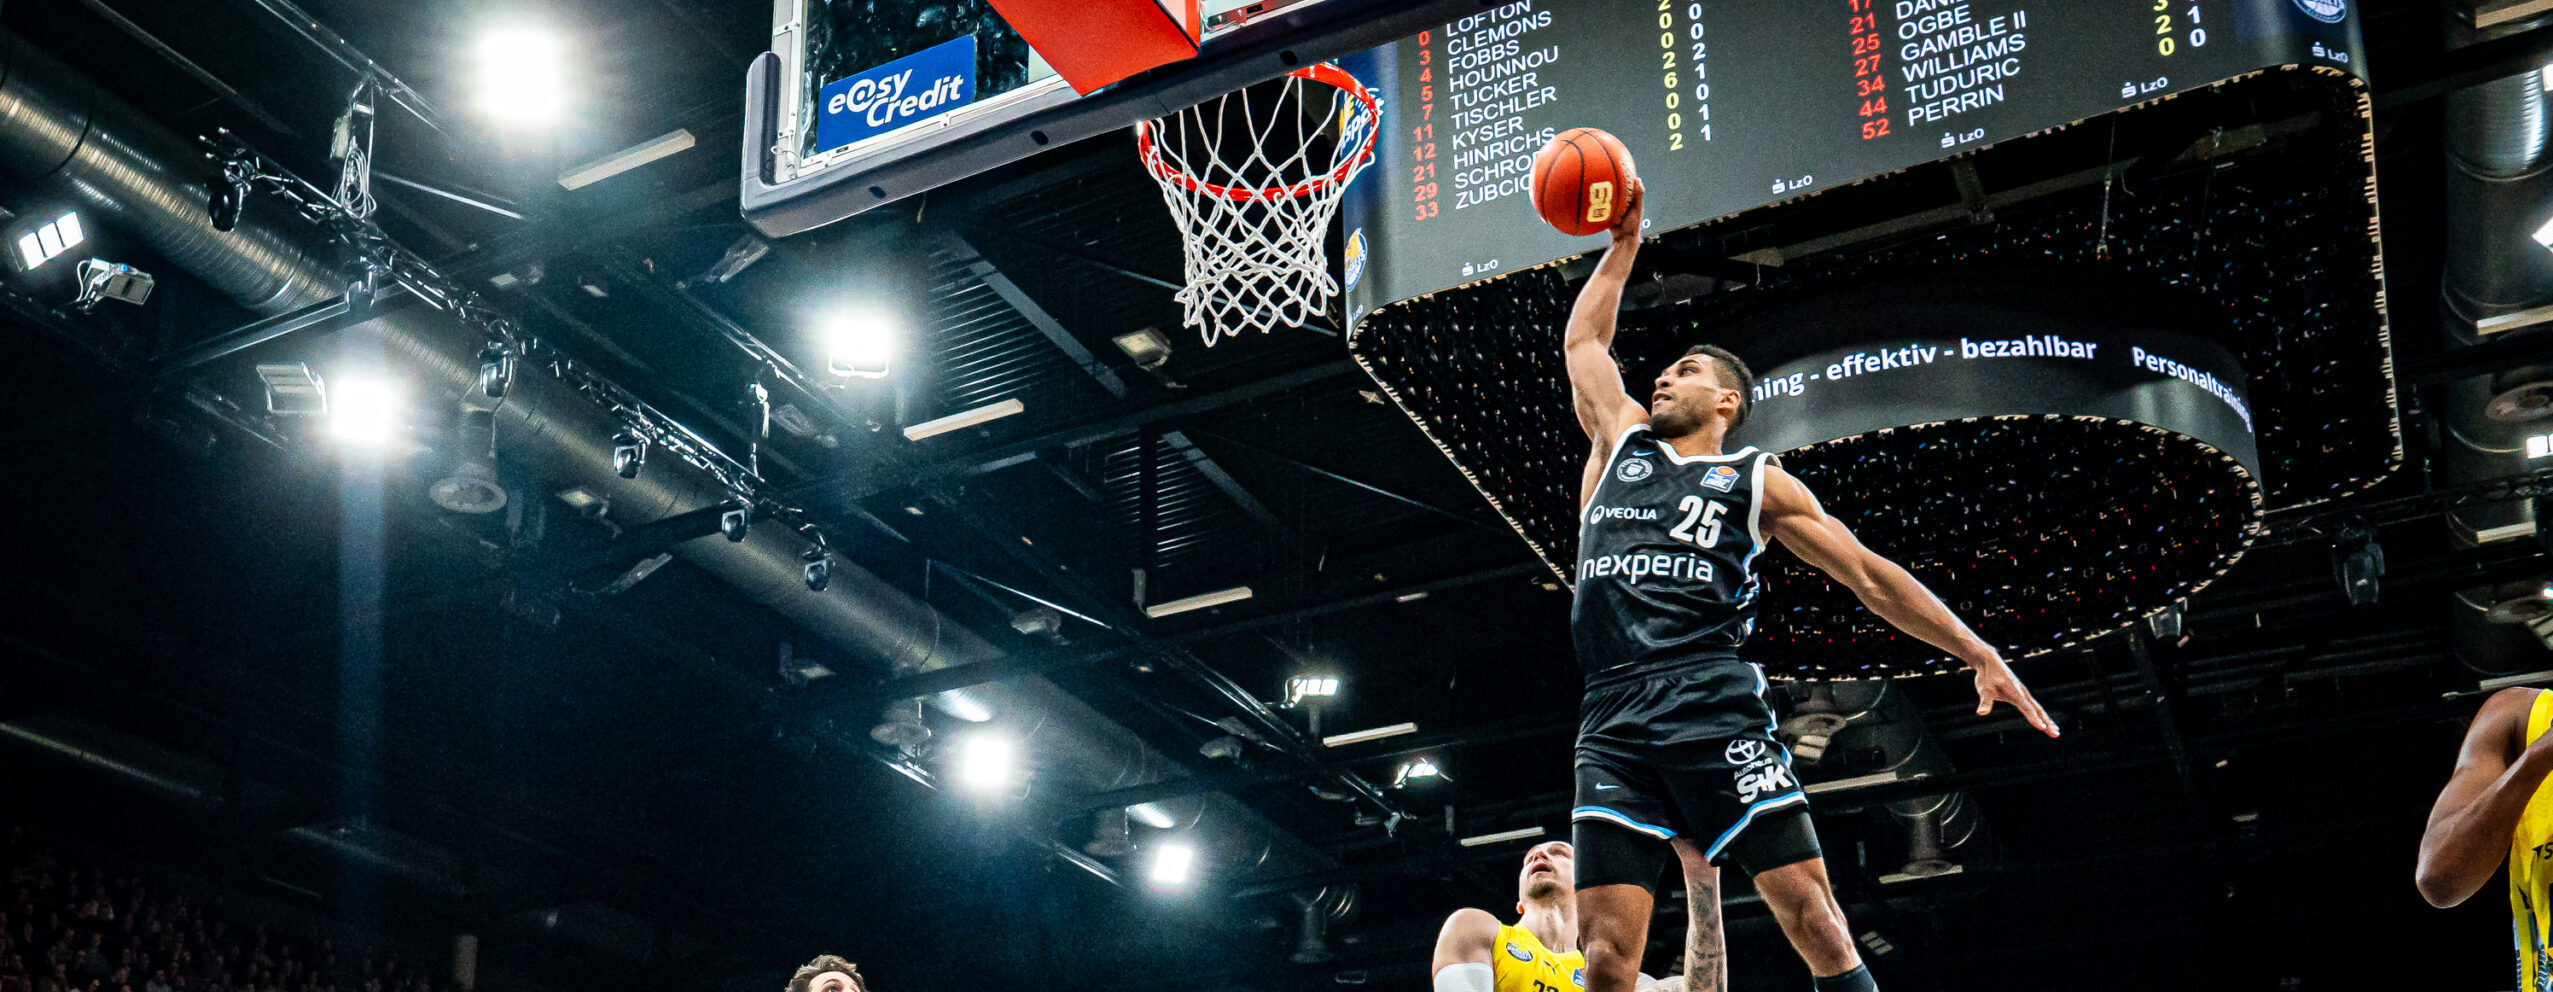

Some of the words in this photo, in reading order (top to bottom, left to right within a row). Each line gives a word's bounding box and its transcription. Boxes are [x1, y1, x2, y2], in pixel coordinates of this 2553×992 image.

[1418, 30, 1430, 47] 0
[1446, 0, 1531, 37] LOFTON
[1659, 12, 1672, 29] 0
[1688, 3, 1702, 20] 0
[1850, 12, 1875, 35] 21
[1898, 4, 1972, 40] OGBE
[2155, 14, 2172, 35] 2
[2187, 5, 2200, 24] 1
[1419, 50, 1431, 66] 3
[1447, 10, 1552, 55] CLEMONS
[1661, 32, 1674, 48] 0
[1690, 23, 1704, 39] 0
[1852, 33, 1880, 56] 25
[1900, 16, 2007, 61] GAMBLE
[2013, 10, 2027, 30] II
[2158, 37, 2175, 56] 0
[2190, 28, 2206, 47] 0
[1420, 67, 1433, 83] 4
[1449, 40, 1520, 74] FOBBS
[1662, 51, 1676, 69] 2
[1692, 42, 1706, 60] 2
[1854, 53, 1882, 77] 27
[1902, 33, 2026, 82] WILLIAMS
[1421, 85, 1433, 102] 5
[1450, 45, 1559, 92] HOUNNOU
[1664, 72, 1678, 89] 6
[1695, 62, 1705, 79] 1
[1857, 74, 1886, 97] 34
[1905, 57, 2020, 103] TUDURIC
[2140, 76, 2168, 94] LzO
[866, 74, 964, 128] Credit
[1421, 103, 1434, 120] 7
[1450, 72, 1538, 110] TUCKER
[1666, 92, 1679, 109] 0
[1696, 83, 1709, 100] 0
[1859, 96, 1888, 118] 44
[1908, 83, 2004, 127] PERRIN
[1413, 123, 1433, 142] 11
[1451, 86, 1557, 130] TISCHLER
[1667, 112, 1681, 130] 0
[1699, 103, 1710, 120] 1
[1413, 143, 1436, 162] 12
[1452, 116, 1524, 150] KYSER
[1669, 132, 1684, 151] 2
[1700, 123, 1711, 141] 1
[1862, 118, 1891, 140] 52
[1959, 128, 1985, 144] LzO
[1413, 162, 1435, 183] 21
[1453, 127, 1556, 170] HINRICHS
[1413, 182, 1438, 202] 29
[1454, 151, 1538, 189] SCHRO
[1789, 175, 1813, 190] LzO
[1415, 201, 1439, 221] 33
[1476, 259, 1499, 273] LzO
[1752, 372, 1805, 403] ning
[1826, 343, 1937, 381] effektiv
[1961, 335, 2097, 360] bezahlbar
[2132, 346, 2252, 433] Personaltraining
[1605, 507, 1658, 520] VEOLIA
[1669, 495, 1728, 549] 25
[1581, 553, 1714, 585] nexperia
